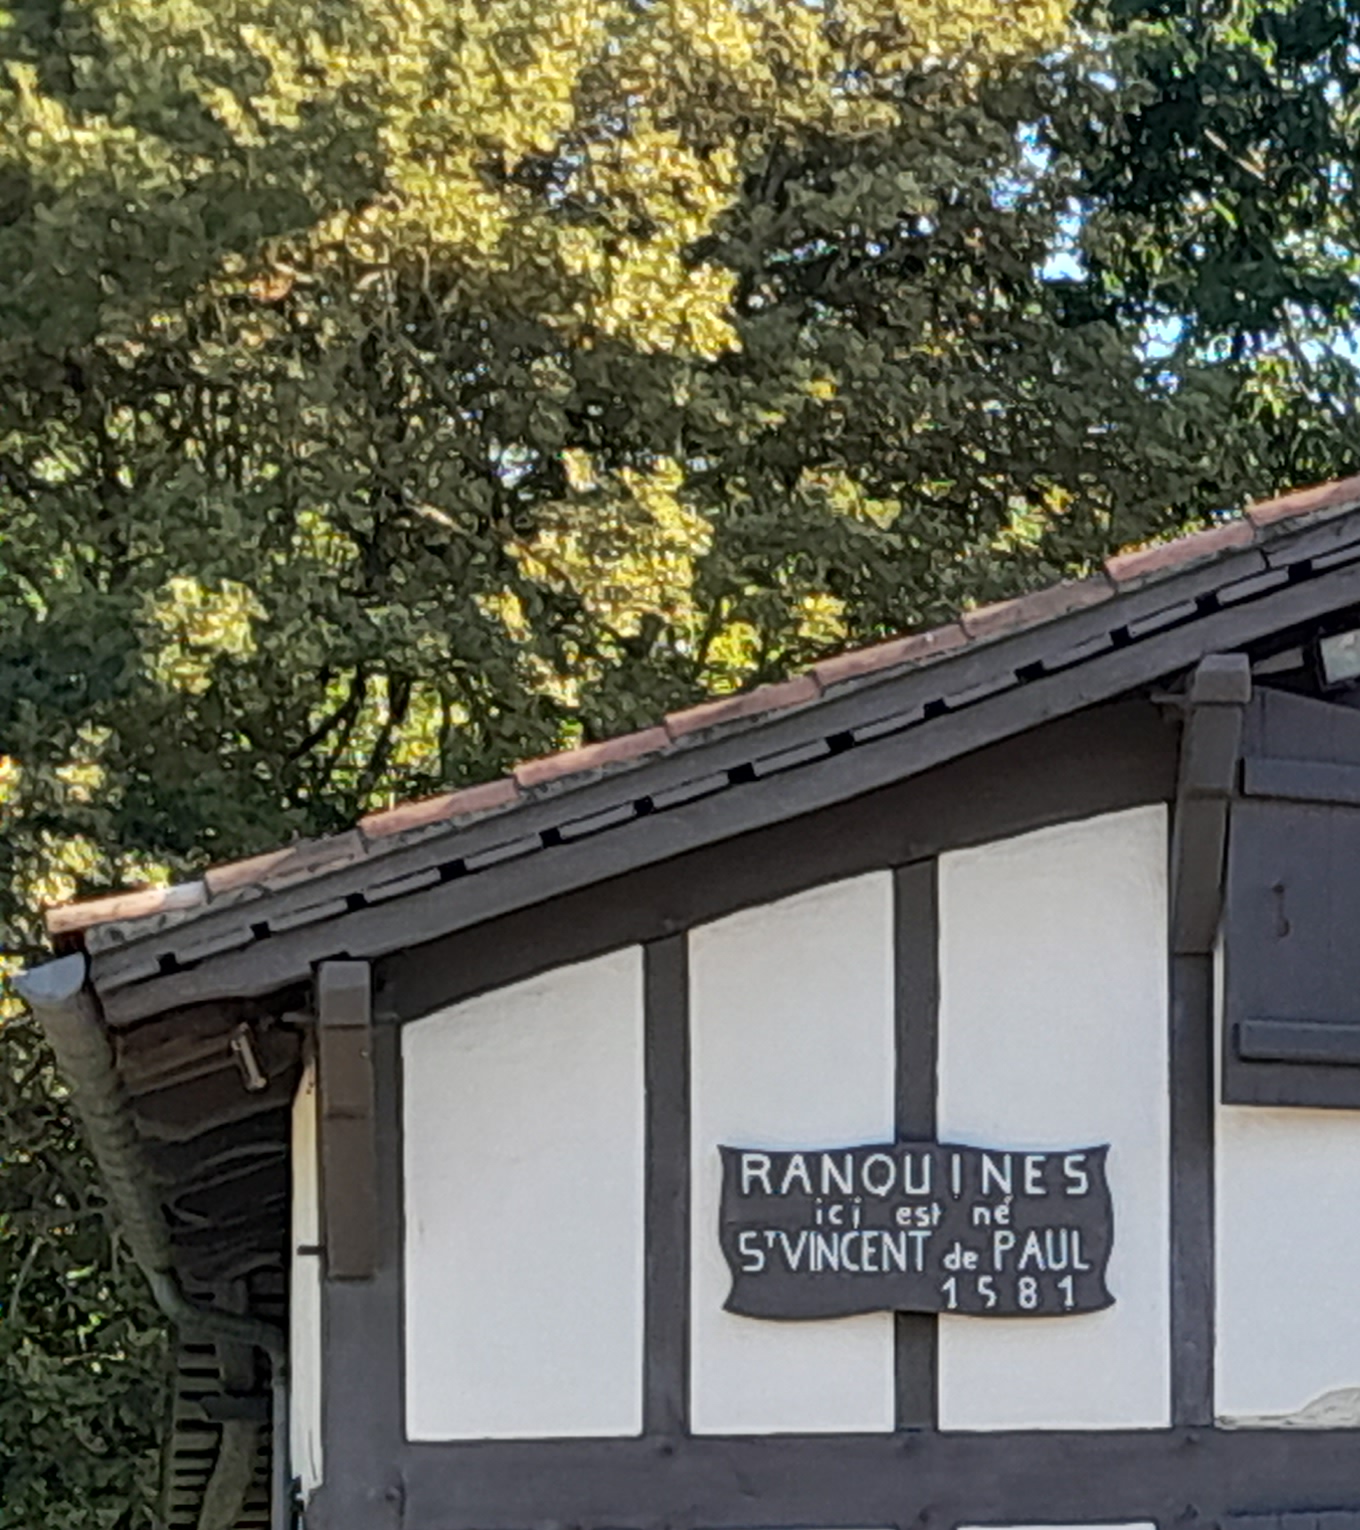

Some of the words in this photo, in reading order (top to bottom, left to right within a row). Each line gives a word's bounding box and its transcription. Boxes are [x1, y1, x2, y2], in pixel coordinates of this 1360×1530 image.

[741, 1153, 1089, 1195] RANQUINES
[815, 1198, 863, 1228] ici
[895, 1203, 941, 1226] est
[973, 1195, 1013, 1225] né
[943, 1243, 978, 1270] de
[993, 1229, 1089, 1270] PAUL
[942, 1275, 1075, 1309] 1581
